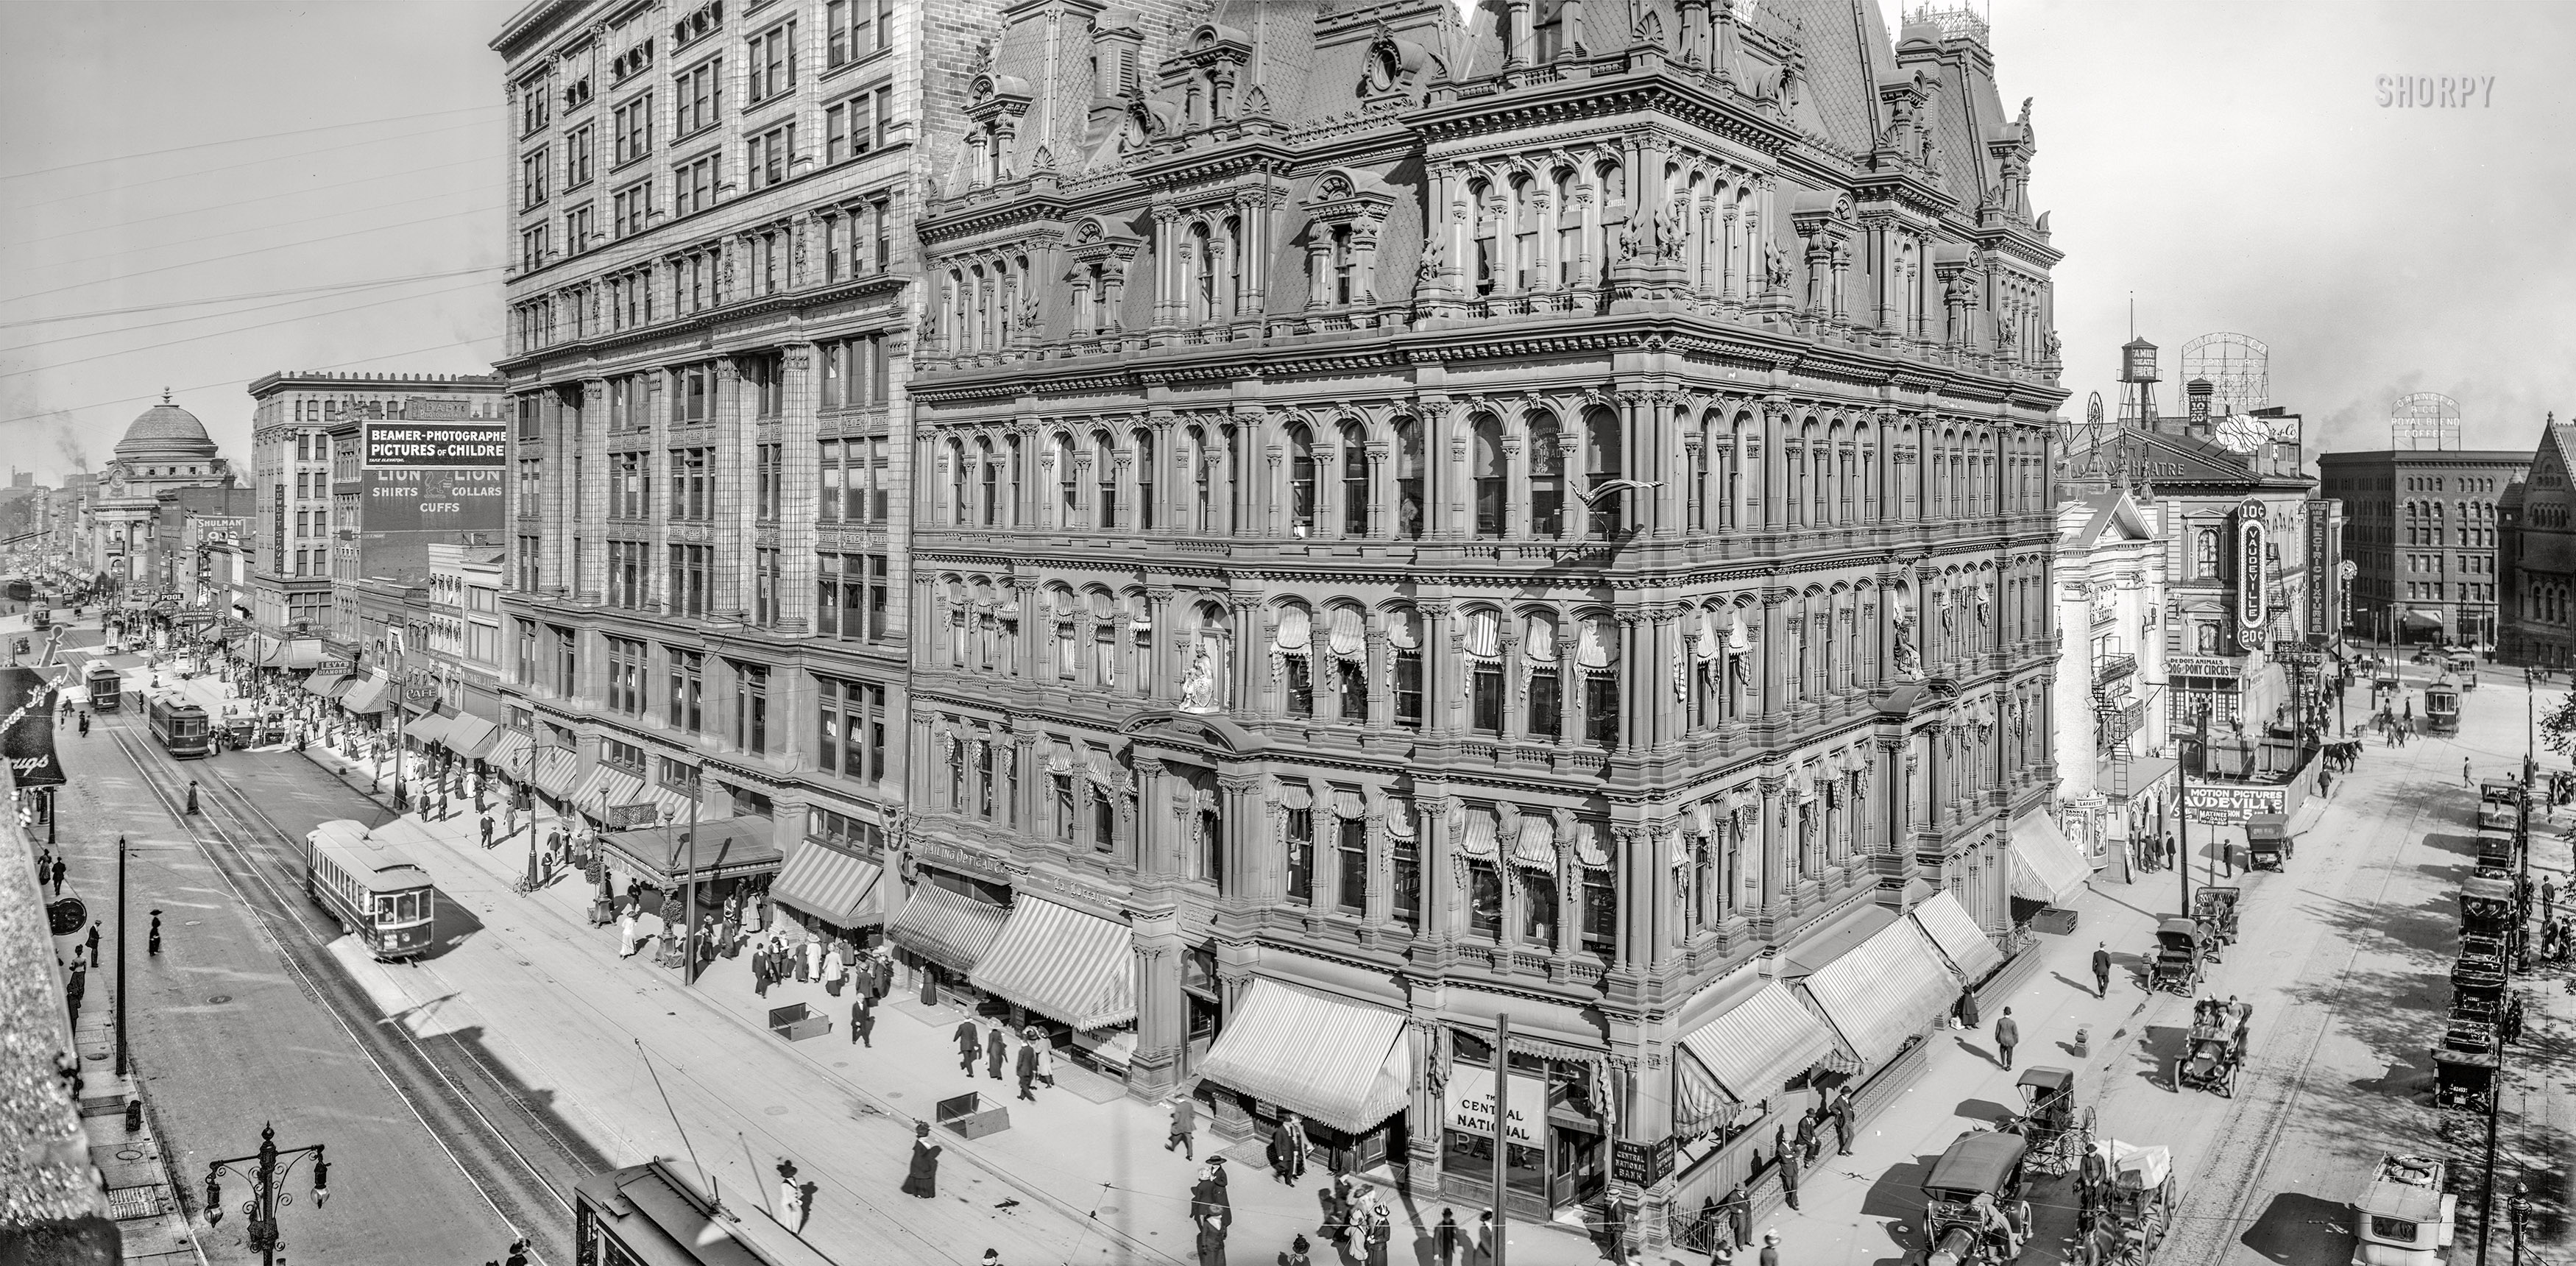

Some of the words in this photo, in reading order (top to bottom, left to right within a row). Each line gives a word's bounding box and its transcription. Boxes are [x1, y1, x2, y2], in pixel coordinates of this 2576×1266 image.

[2249, 339, 2267, 353] CO
[2192, 402, 2205, 410] 10
[2422, 406, 2437, 414] CO
[372, 430, 506, 442] BEAMER-PHOTOGRAPHE
[2405, 429, 2446, 438] COFFEE
[371, 444, 436, 456] PICTURES
[447, 445, 506, 456] CHILDRE
[372, 487, 418, 497] SHIRTS
[451, 487, 502, 497] COLLARS
[419, 502, 460, 513] CUFFS
[2243, 505, 2265, 518] 10¢
[197, 518, 242, 528] SHULMAN
[2313, 516, 2323, 573] ELECTRIC
[2248, 530, 2258, 617] VAUDEVILLE
[2312, 575, 2322, 632] FIXTURES
[431, 604, 444, 612] HOTEL
[444, 606, 462, 616] MOHAWK
[291, 616, 314, 624] SHIRTS
[2242, 630, 2264, 643] 20¢
[2185, 664, 2203, 675] PONY
[2204, 665, 2229, 676] CIRCUS
[406, 688, 436, 700] CAFE
[2190, 788, 2230, 798] MOTION
[2234, 790, 2283, 799] PICTURES
[2199, 810, 2228, 818] MATINEE
[2243, 809, 2253, 821] 5
[924, 841, 955, 860] FAILING
[957, 849, 992, 871] OPTICAL
[1485, 1093, 1496, 1101] TH
[1462, 1099, 1524, 1122] CENTAL
[1623, 1145, 1638, 1153] THE
[1616, 1150, 1645, 1163] CENTRAL
[1615, 1159, 1646, 1173] NATIONAL
[1618, 1168, 1642, 1181] BANK
